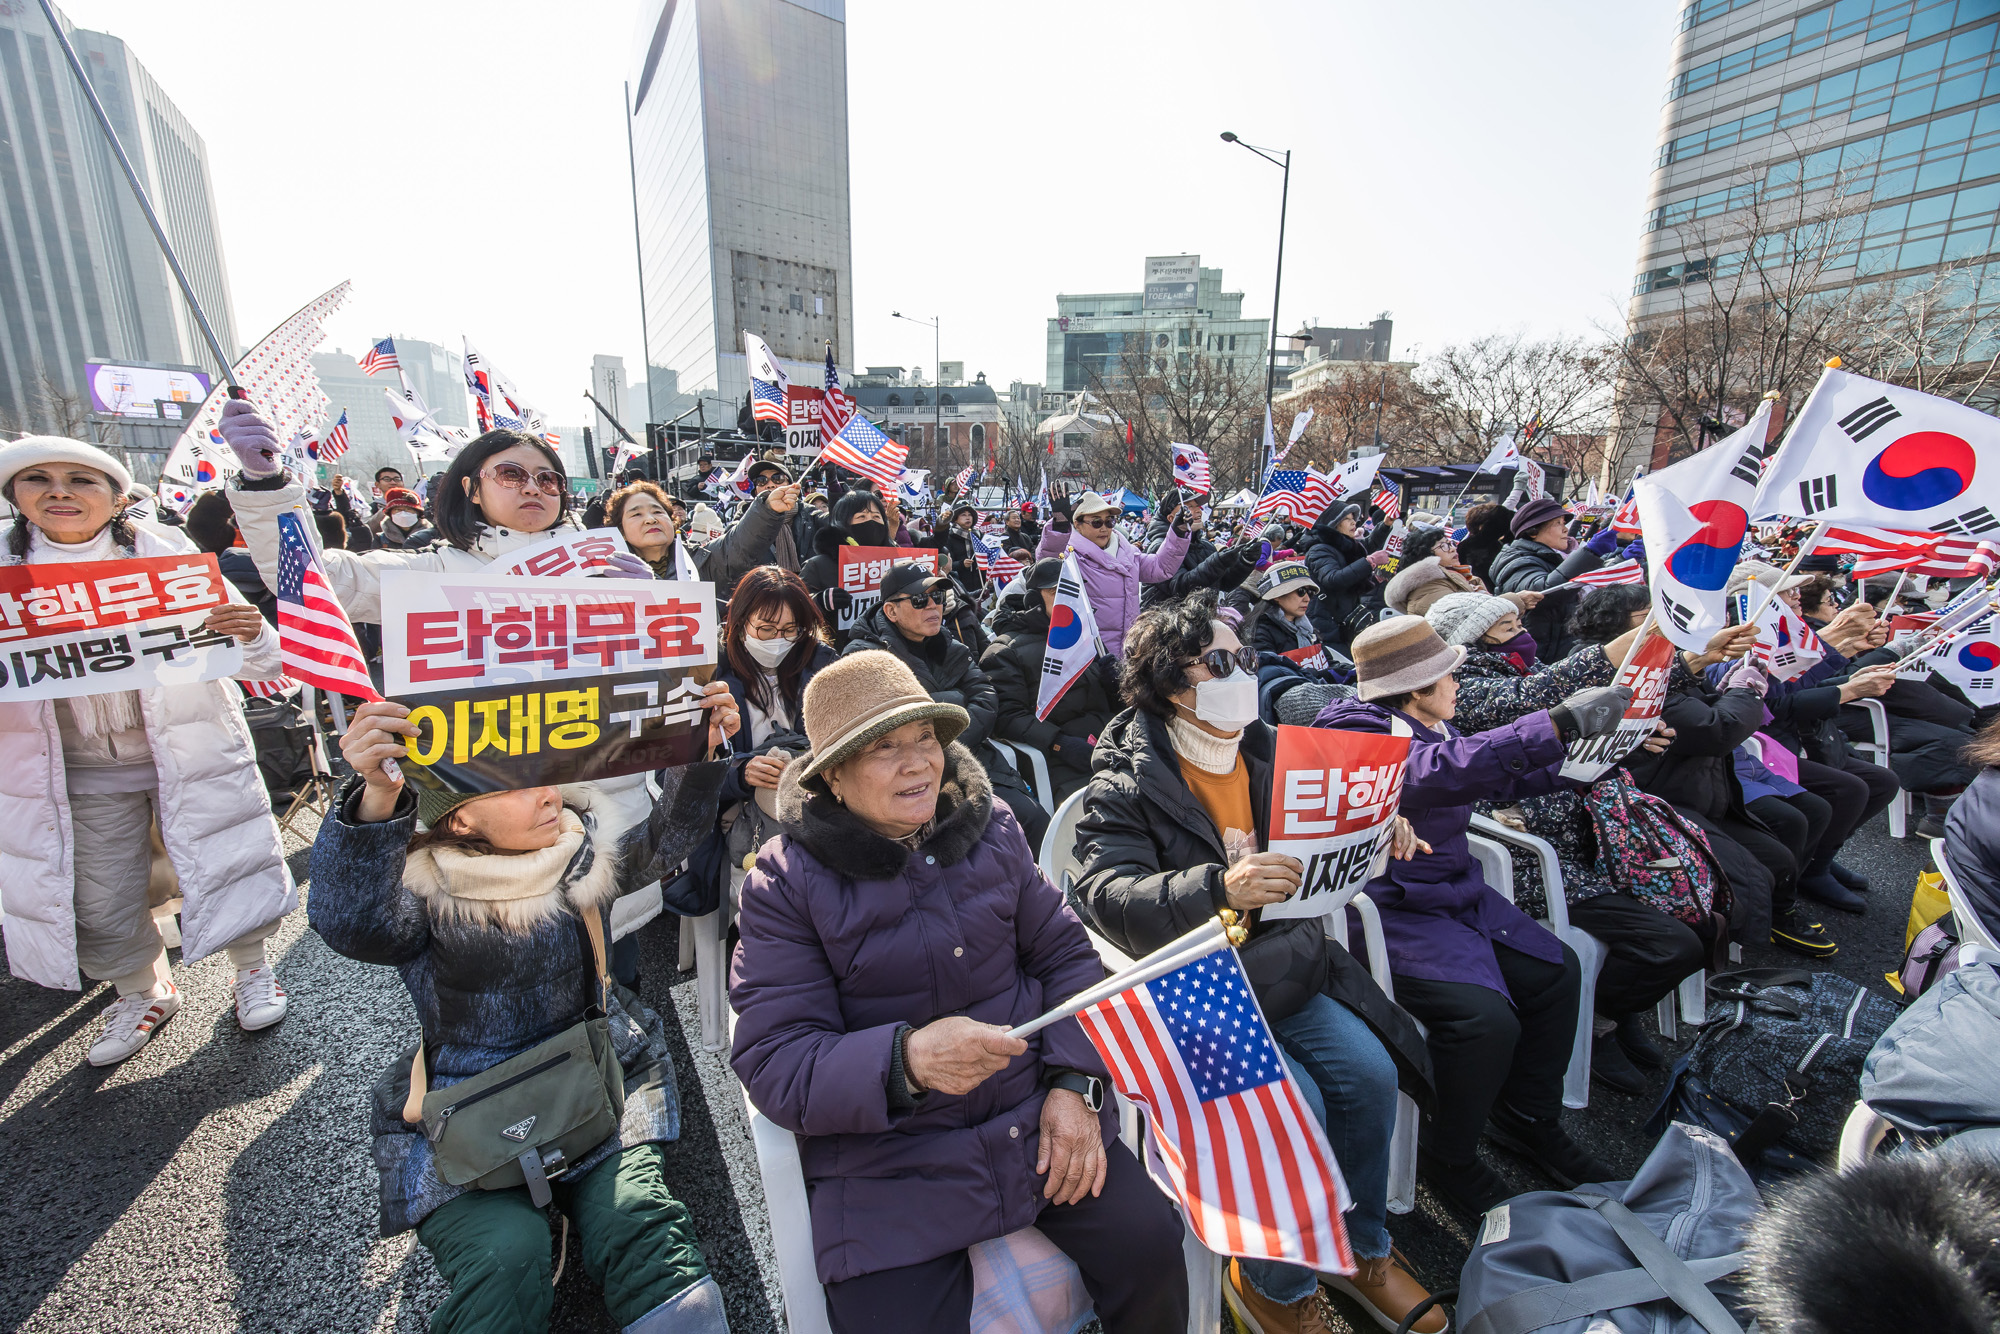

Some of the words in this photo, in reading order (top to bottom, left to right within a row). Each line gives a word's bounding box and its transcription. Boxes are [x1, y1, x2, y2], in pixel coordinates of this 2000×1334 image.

[1148, 292, 1172, 300] TOEFL
[791, 399, 854, 424] 탄핵효
[1527, 461, 1541, 479] STOP
[1528, 475, 1539, 492] THE
[506, 536, 617, 576] 무효
[843, 554, 936, 592] 탄핵효
[406, 597, 705, 683] 탄핵무효
[402, 686, 601, 766] 이재명
[609, 676, 705, 739] 구속
